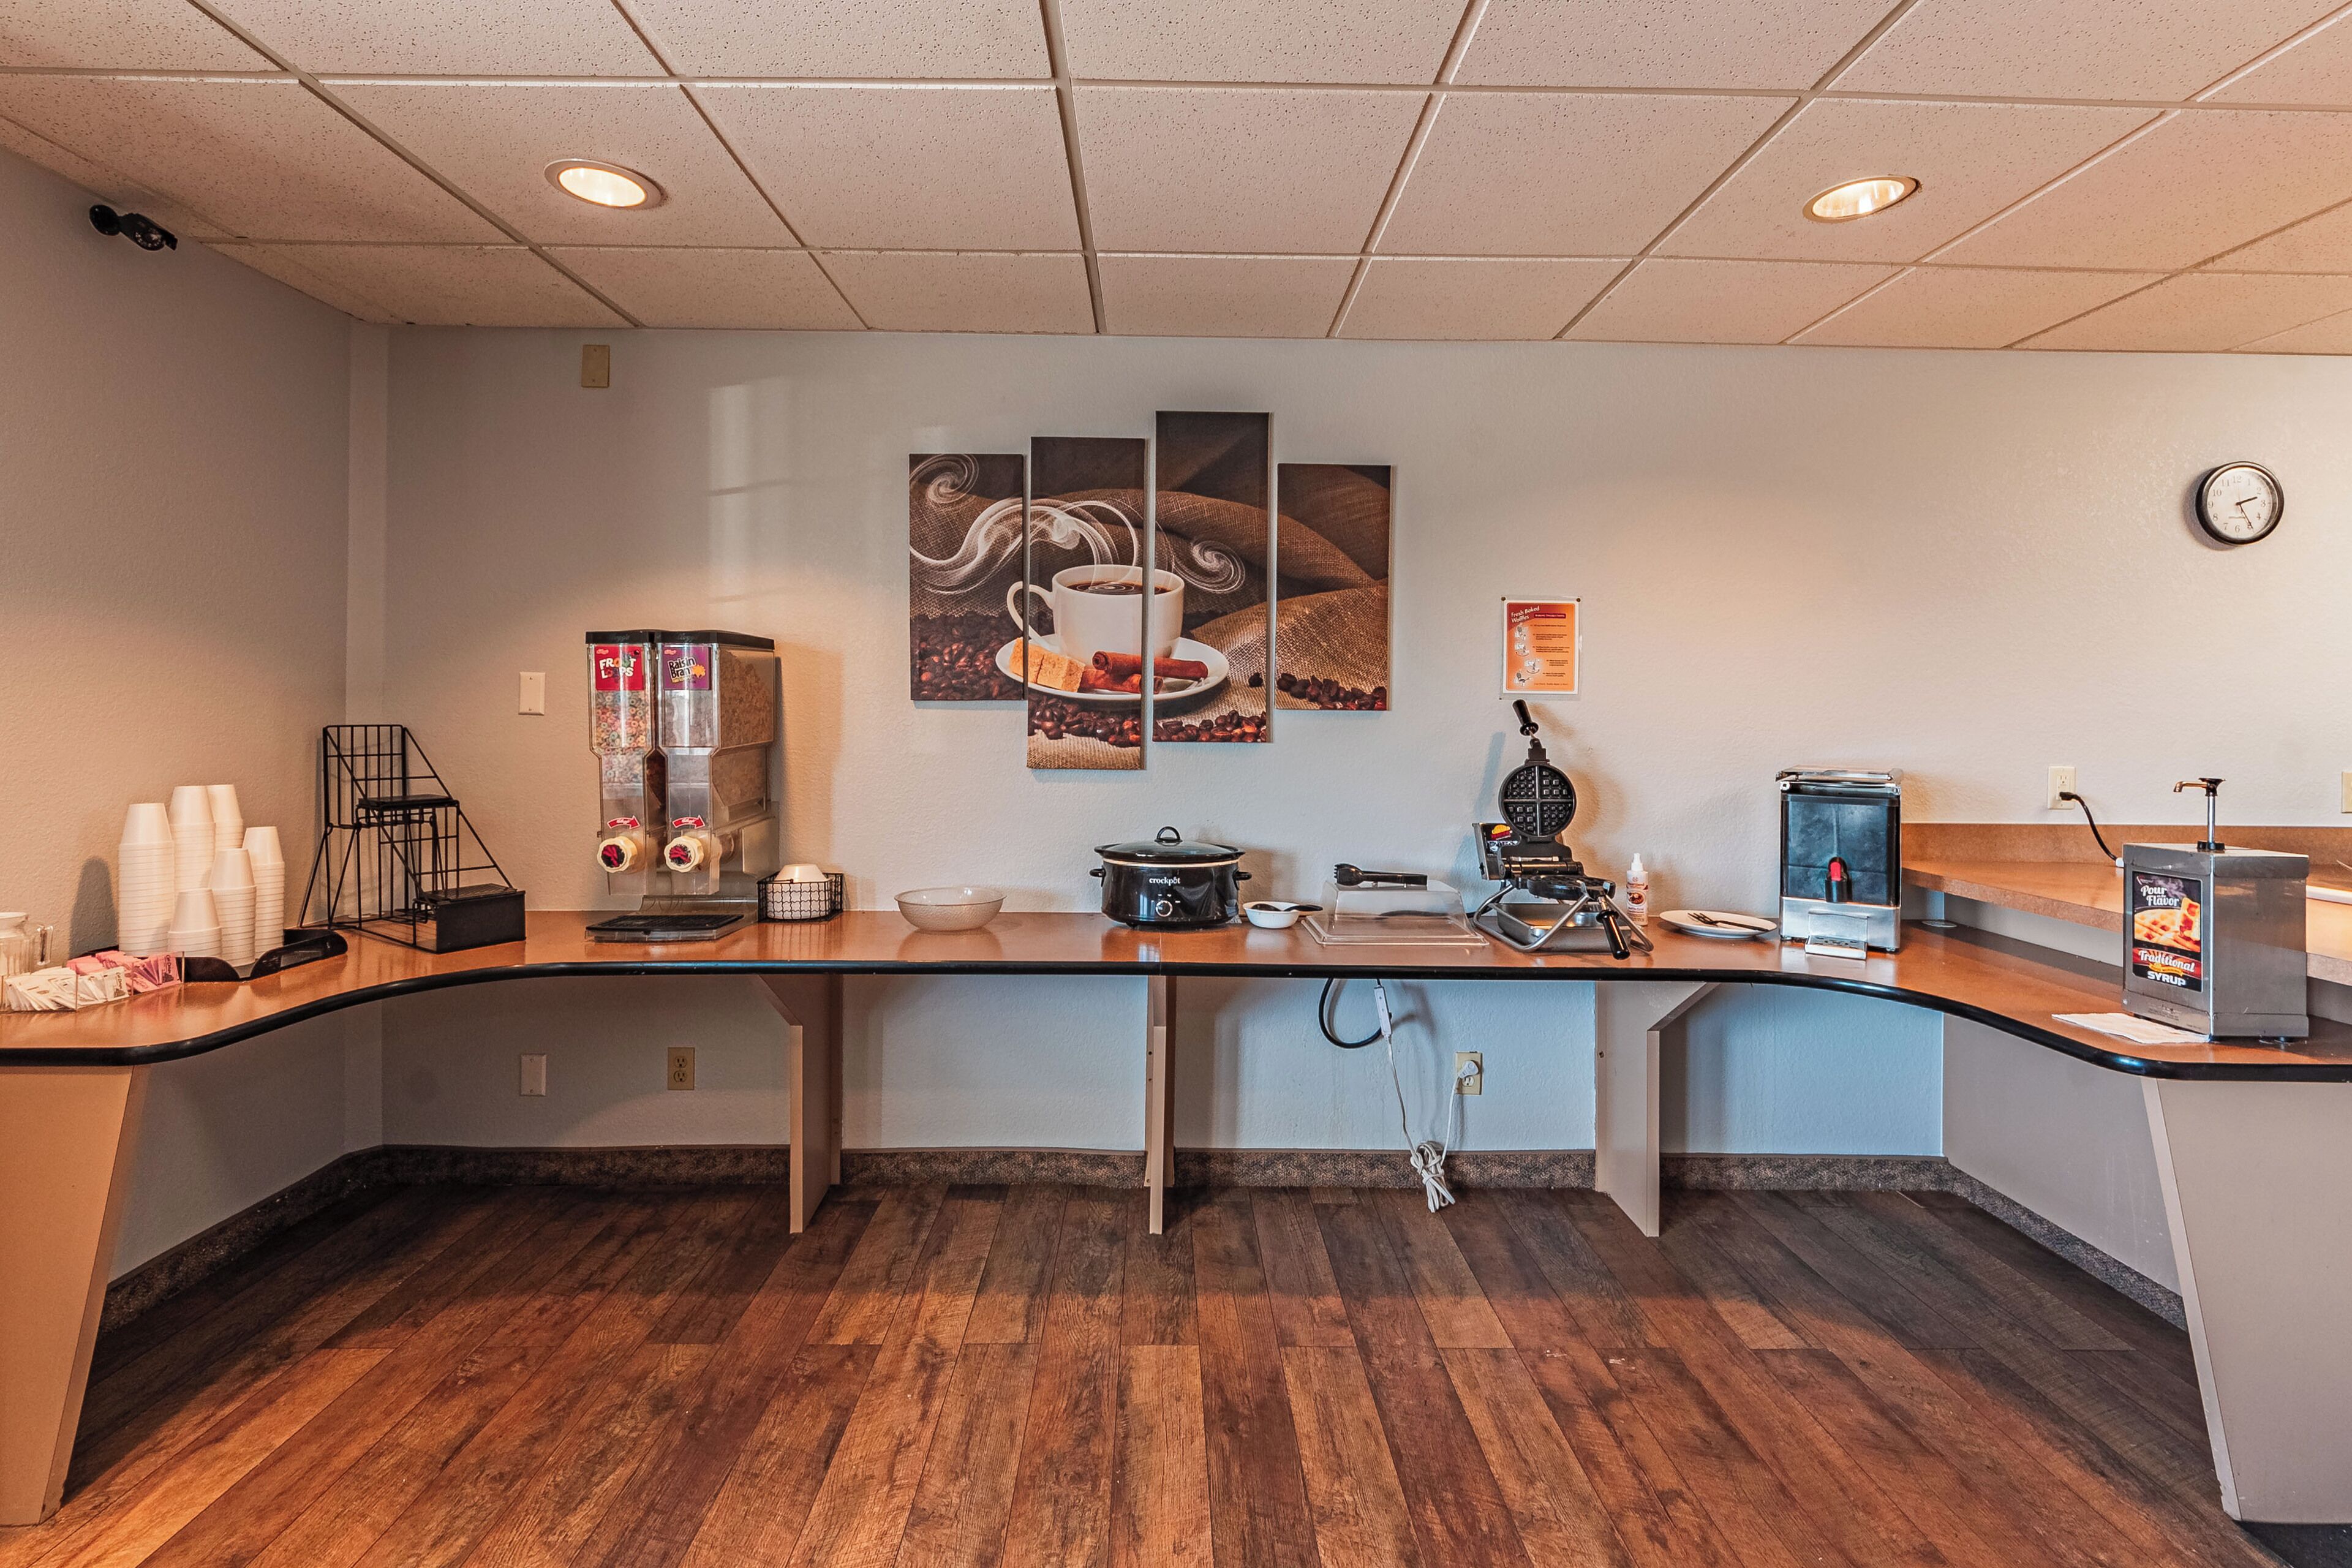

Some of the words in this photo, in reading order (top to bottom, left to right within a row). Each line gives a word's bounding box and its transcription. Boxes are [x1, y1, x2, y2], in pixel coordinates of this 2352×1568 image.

[599, 657, 636, 670] FROOT
[668, 657, 696, 669] Raisin
[670, 668, 691, 679] Bran
[1149, 876, 1180, 886] crockpot
[2141, 885, 2168, 897] Pour
[2146, 895, 2179, 907] Flavor
[2138, 950, 2195, 973] Traditional
[2147, 970, 2187, 986] SYRUP
